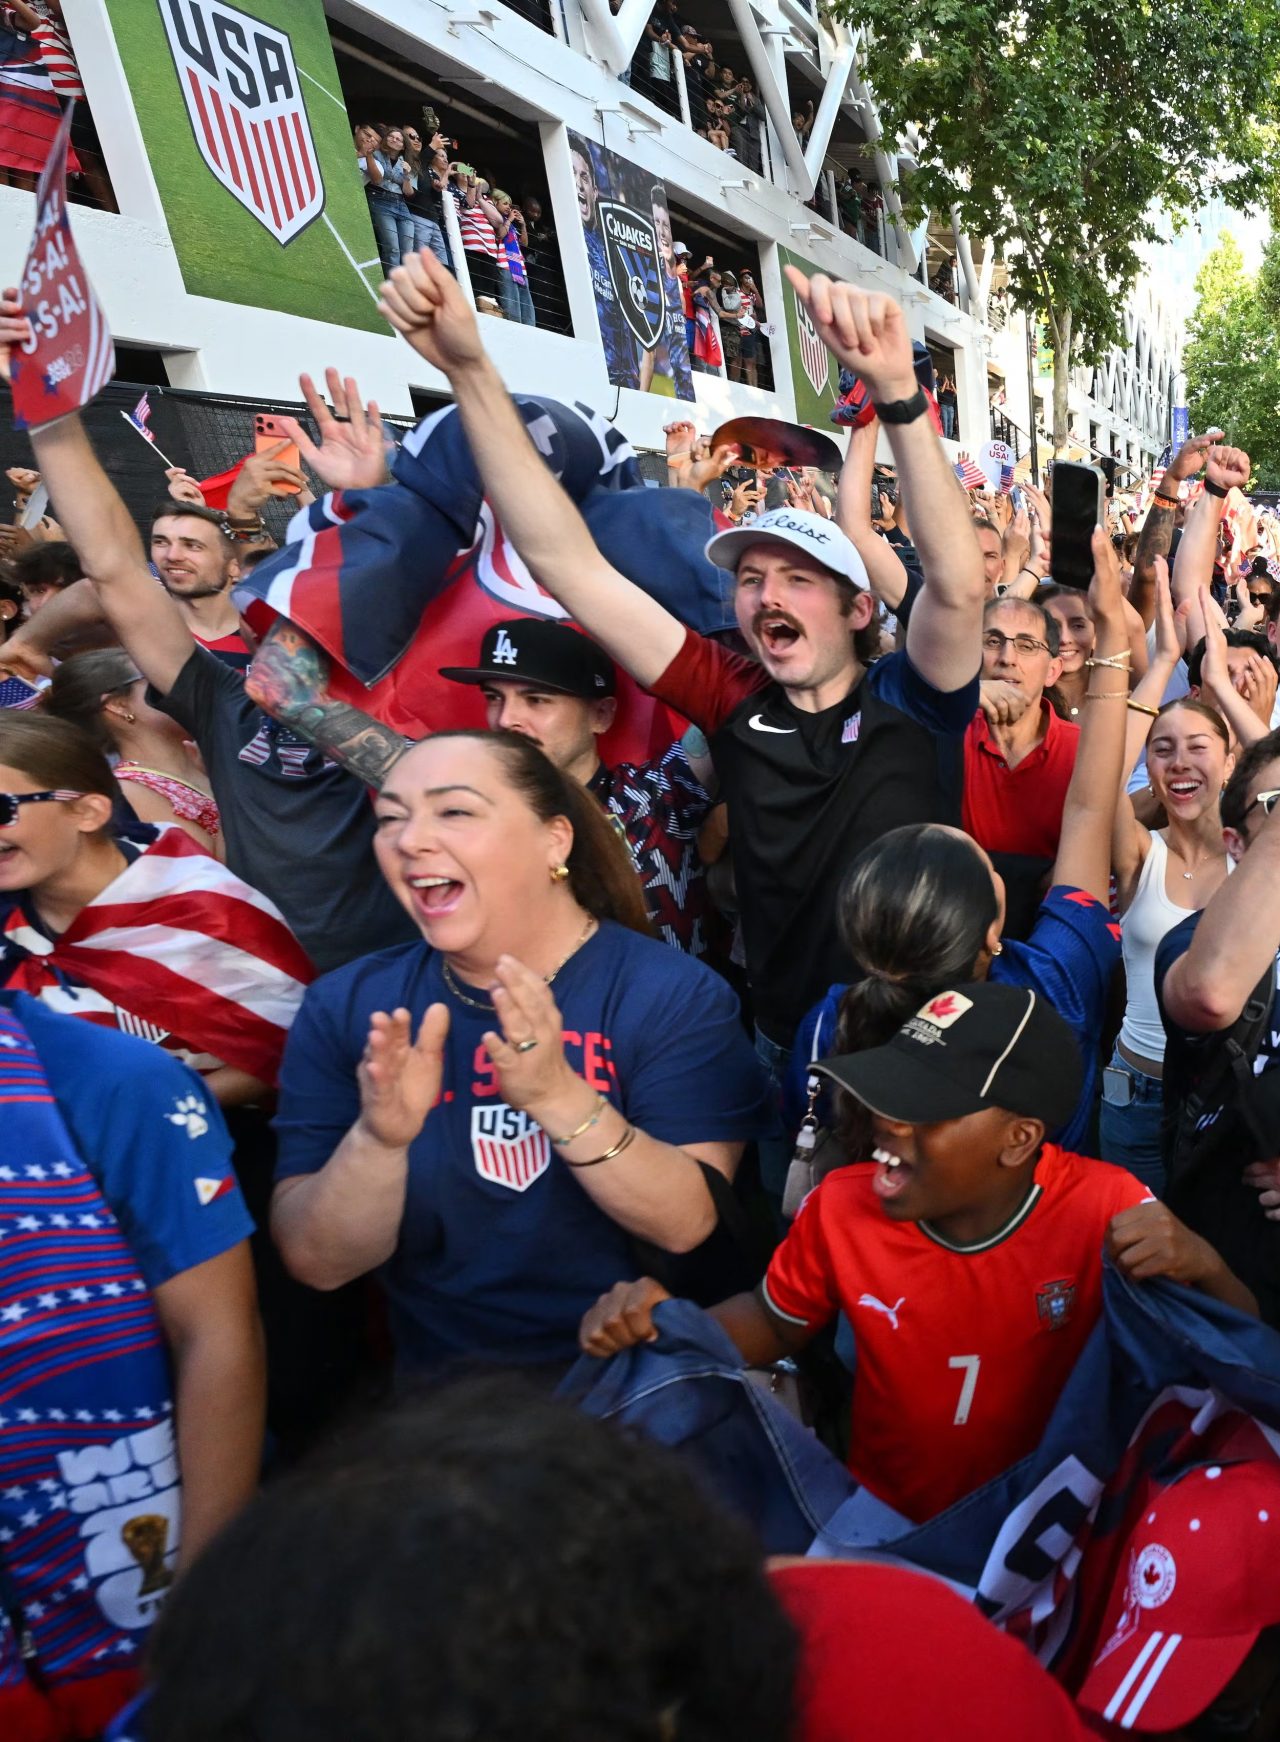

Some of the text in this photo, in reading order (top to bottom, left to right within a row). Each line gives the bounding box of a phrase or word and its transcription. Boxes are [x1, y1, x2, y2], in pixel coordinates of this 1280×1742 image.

[168, 0, 294, 109] USA
[606, 213, 653, 251] QUAKES
[989, 450, 1009, 461] USA!
[993, 443, 1007, 452] GO
[492, 629, 518, 666] LA
[948, 1354, 981, 1425] 7
